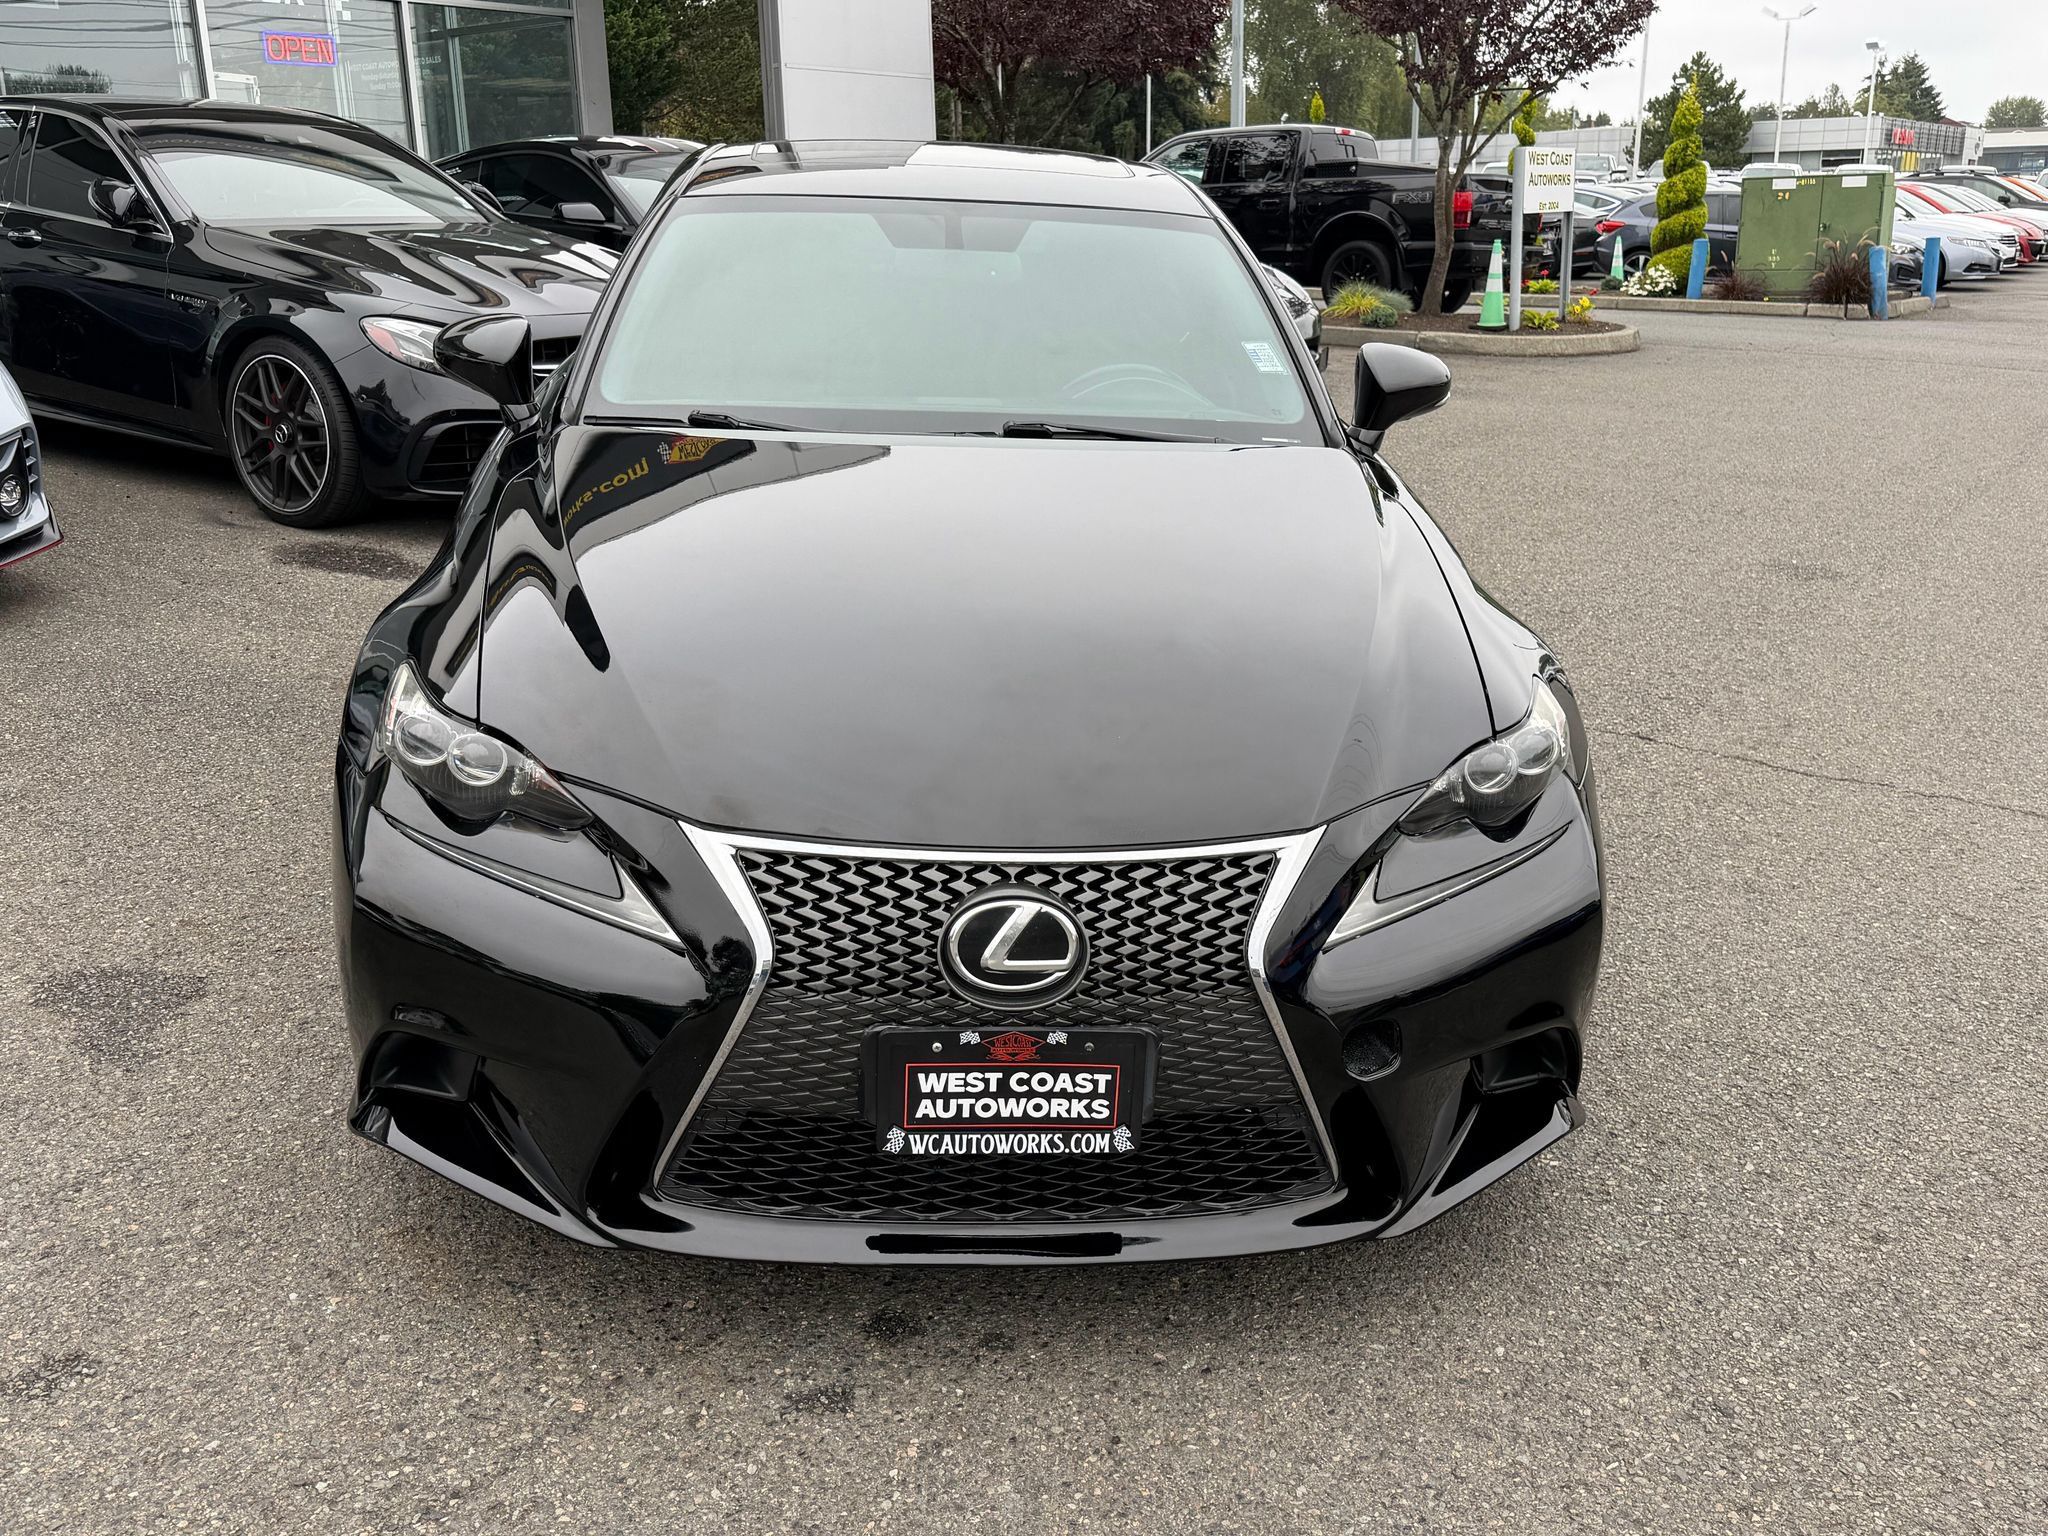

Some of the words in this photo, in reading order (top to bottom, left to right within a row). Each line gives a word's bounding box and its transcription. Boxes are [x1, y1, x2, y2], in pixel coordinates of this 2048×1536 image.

[267, 34, 334, 63] OPEN
[1528, 151, 1549, 166] WEST
[1550, 151, 1573, 166] COAST
[1528, 172, 1571, 186] AUTOWORKS
[917, 1072, 1003, 1093] WEST
[1009, 1072, 1112, 1094] COAST
[915, 1097, 1110, 1119] AUTOWORKS
[908, 1133, 1111, 1155] WCAUTOWORKS.COM
